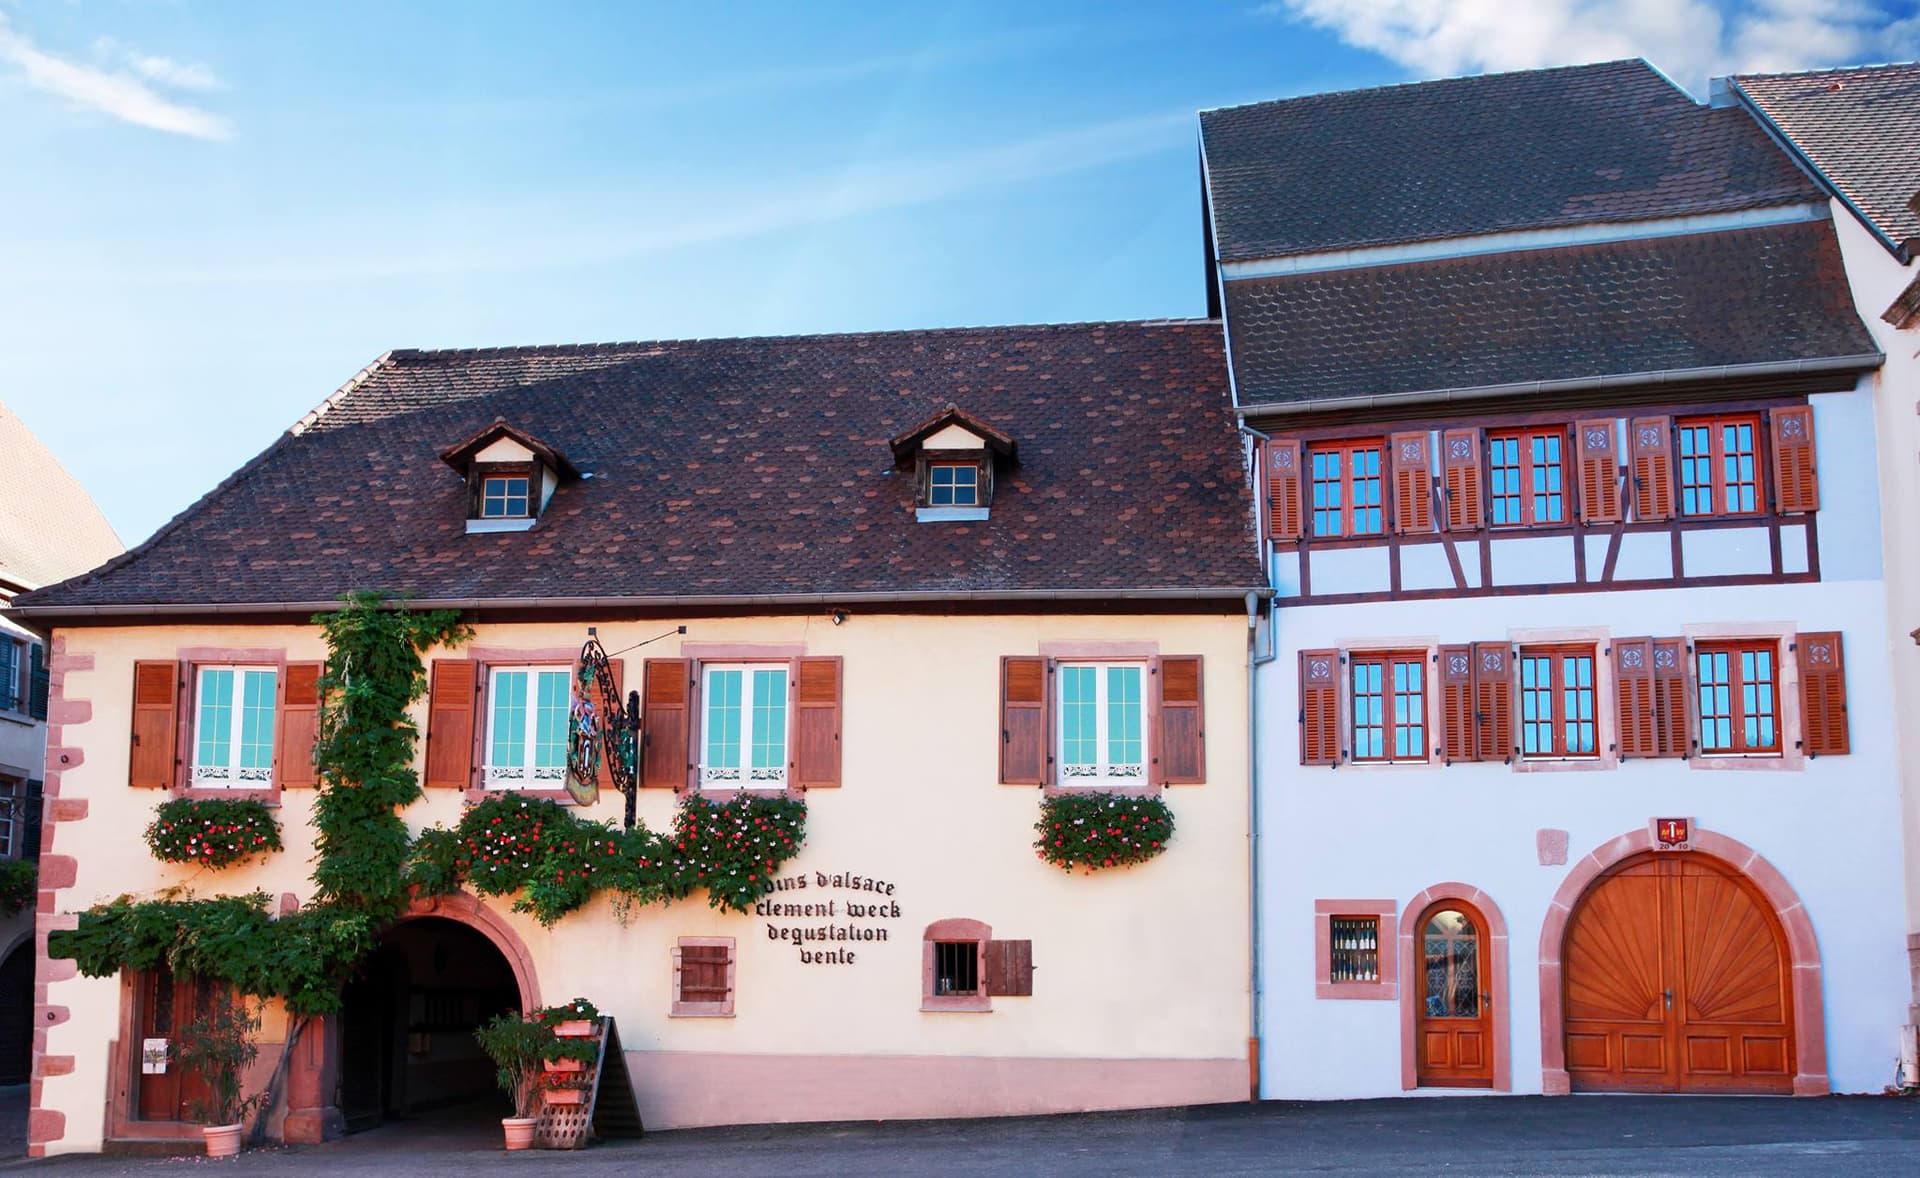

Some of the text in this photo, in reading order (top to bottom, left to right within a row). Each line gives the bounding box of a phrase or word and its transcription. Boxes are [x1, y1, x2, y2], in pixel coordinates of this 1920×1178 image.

[816, 871, 895, 896] d'alsace
[756, 899, 901, 917] clement weck
[767, 923, 888, 945] degustation
[800, 946, 856, 964] vente
